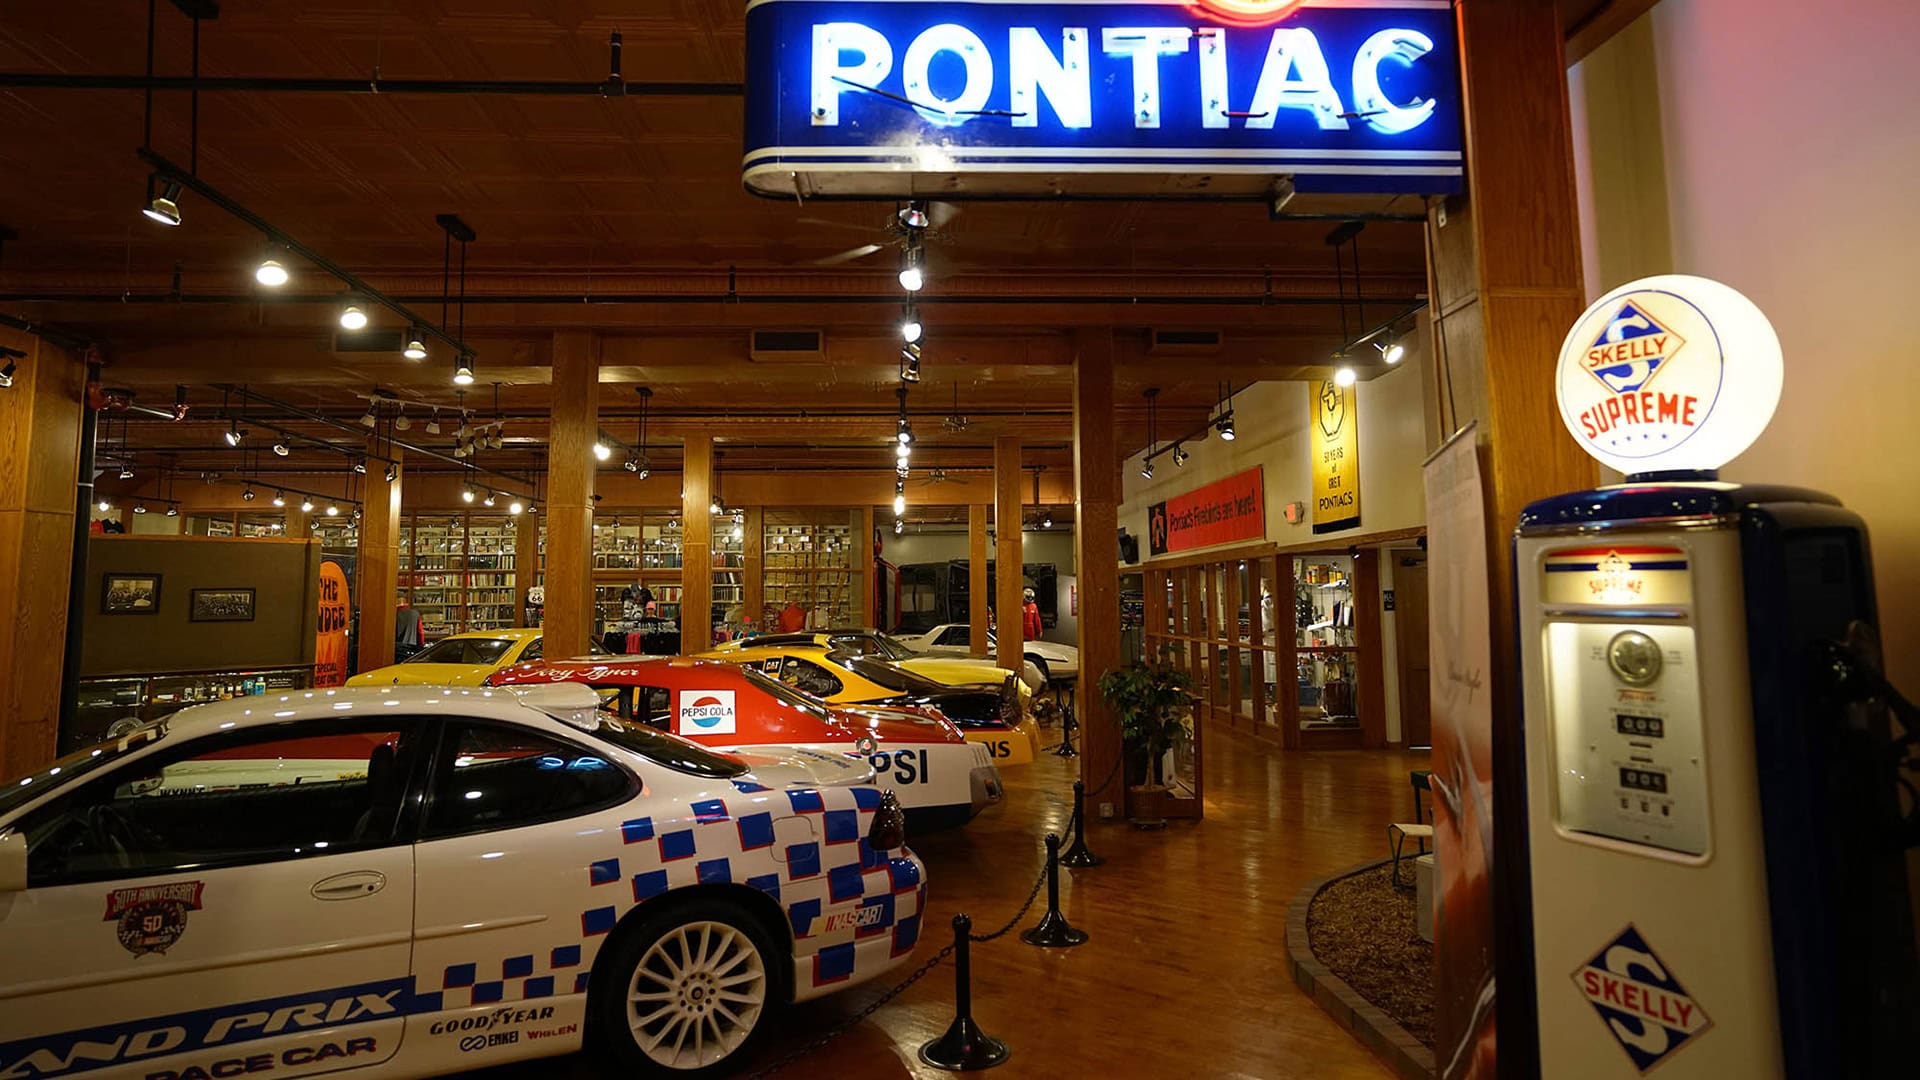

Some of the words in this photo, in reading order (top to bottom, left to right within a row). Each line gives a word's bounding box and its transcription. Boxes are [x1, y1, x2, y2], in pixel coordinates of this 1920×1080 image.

[810, 22, 1437, 133] PONTIAC
[1588, 335, 1668, 367] SKELLY
[1580, 392, 1698, 440] SUPREME
[1319, 492, 1353, 511] PONTIACS
[531, 593, 543, 602] 66
[518, 668, 577, 682] Roy
[577, 667, 640, 681] Tyner
[765, 660, 780, 671] CAT
[682, 706, 708, 717] PEPSI
[709, 706, 733, 717] COLA
[143, 914, 163, 932] 50
[828, 904, 883, 932] NASCAR
[1584, 971, 1693, 1028] SKELLY
[0, 1026, 187, 1076] AND
[203, 990, 402, 1043] PRIX
[488, 1031, 519, 1047] ENKEI
[527, 1024, 577, 1040] WHELEN
[282, 1037, 377, 1066] CAR
